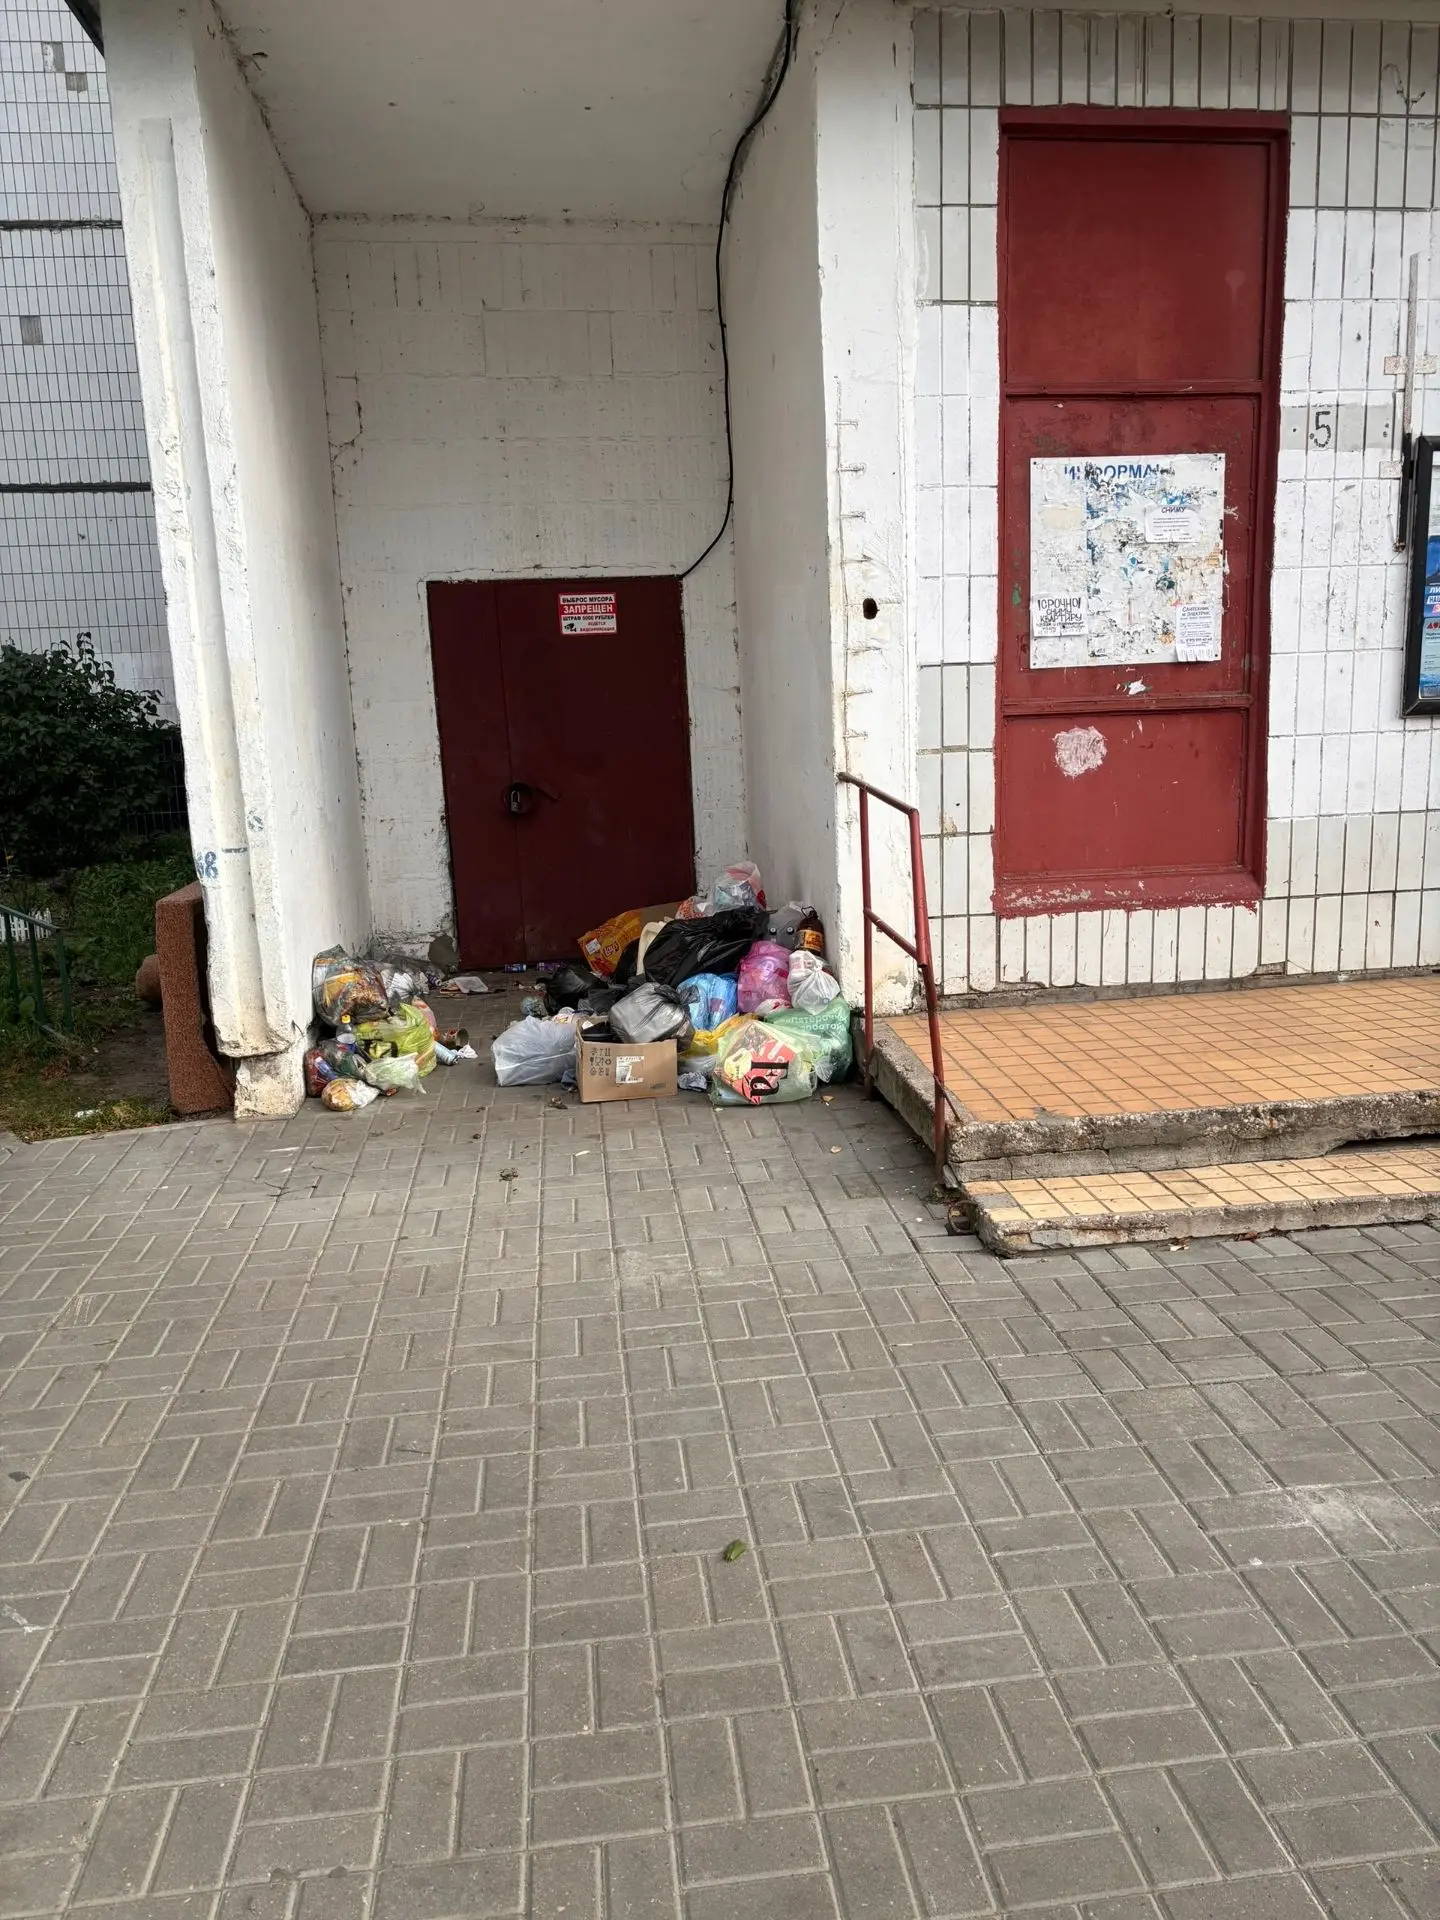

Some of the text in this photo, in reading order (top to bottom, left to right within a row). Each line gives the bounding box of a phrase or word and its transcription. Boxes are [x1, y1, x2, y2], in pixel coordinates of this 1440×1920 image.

[1310, 410, 1332, 448] 5
[563, 604, 613, 614] ЗАПРЕЩЕН
[1040, 613, 1082, 623] КВАРТИРУ
